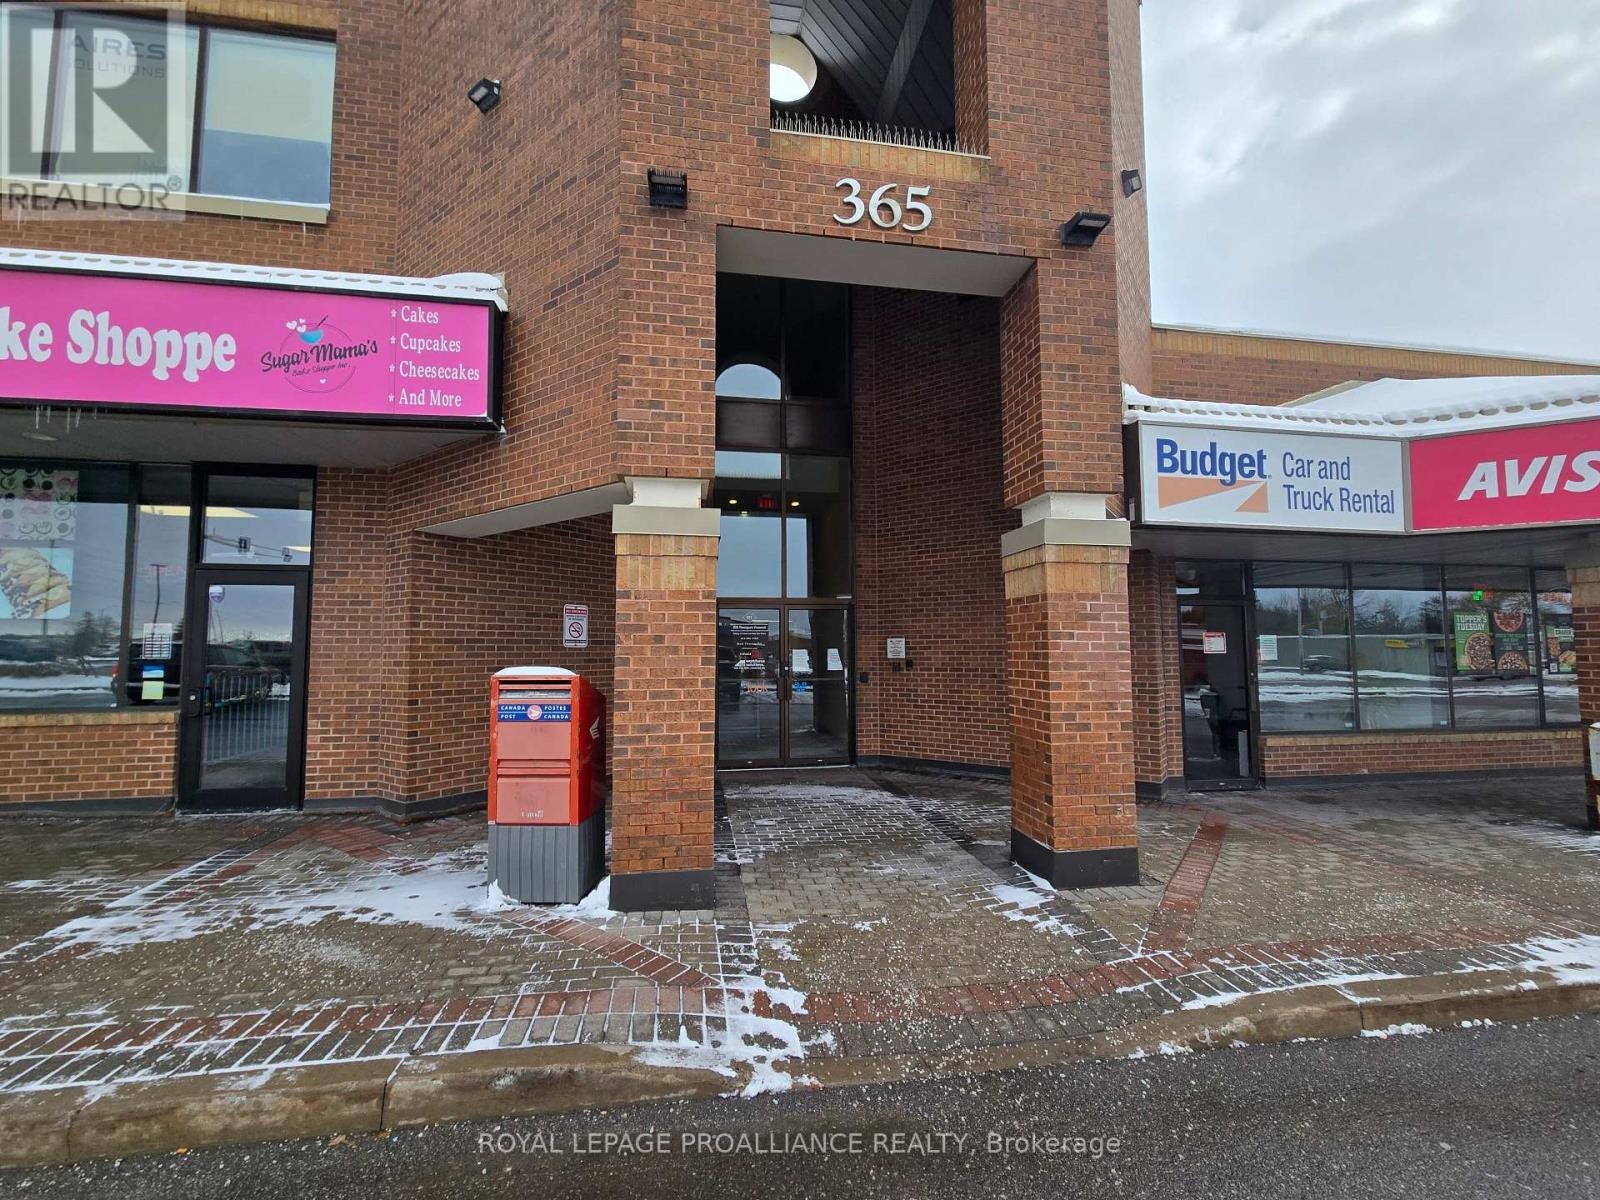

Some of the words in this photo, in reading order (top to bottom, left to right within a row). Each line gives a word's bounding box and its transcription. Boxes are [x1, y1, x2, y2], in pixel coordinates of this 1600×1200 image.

[66, 57, 165, 78] OLUTIONS
[832, 177, 933, 231] 365
[401, 305, 439, 324] Cakes
[67, 309, 236, 382] Shoppe
[400, 332, 462, 354] Cupcakes
[260, 349, 310, 374] Sugar
[310, 339, 378, 363] Mama's
[399, 360, 480, 380] Cheesecakes
[399, 387, 426, 406] And
[430, 389, 462, 407] More
[1156, 438, 1268, 487] Budget
[1282, 451, 1313, 478] Car
[1318, 457, 1351, 481] and
[1457, 450, 1600, 501] AVIS
[1283, 484, 1335, 511] Truck
[1340, 487, 1395, 514] Rental
[1455, 614, 1488, 623] TOPPER'S
[1456, 622, 1485, 631] TUESDAY
